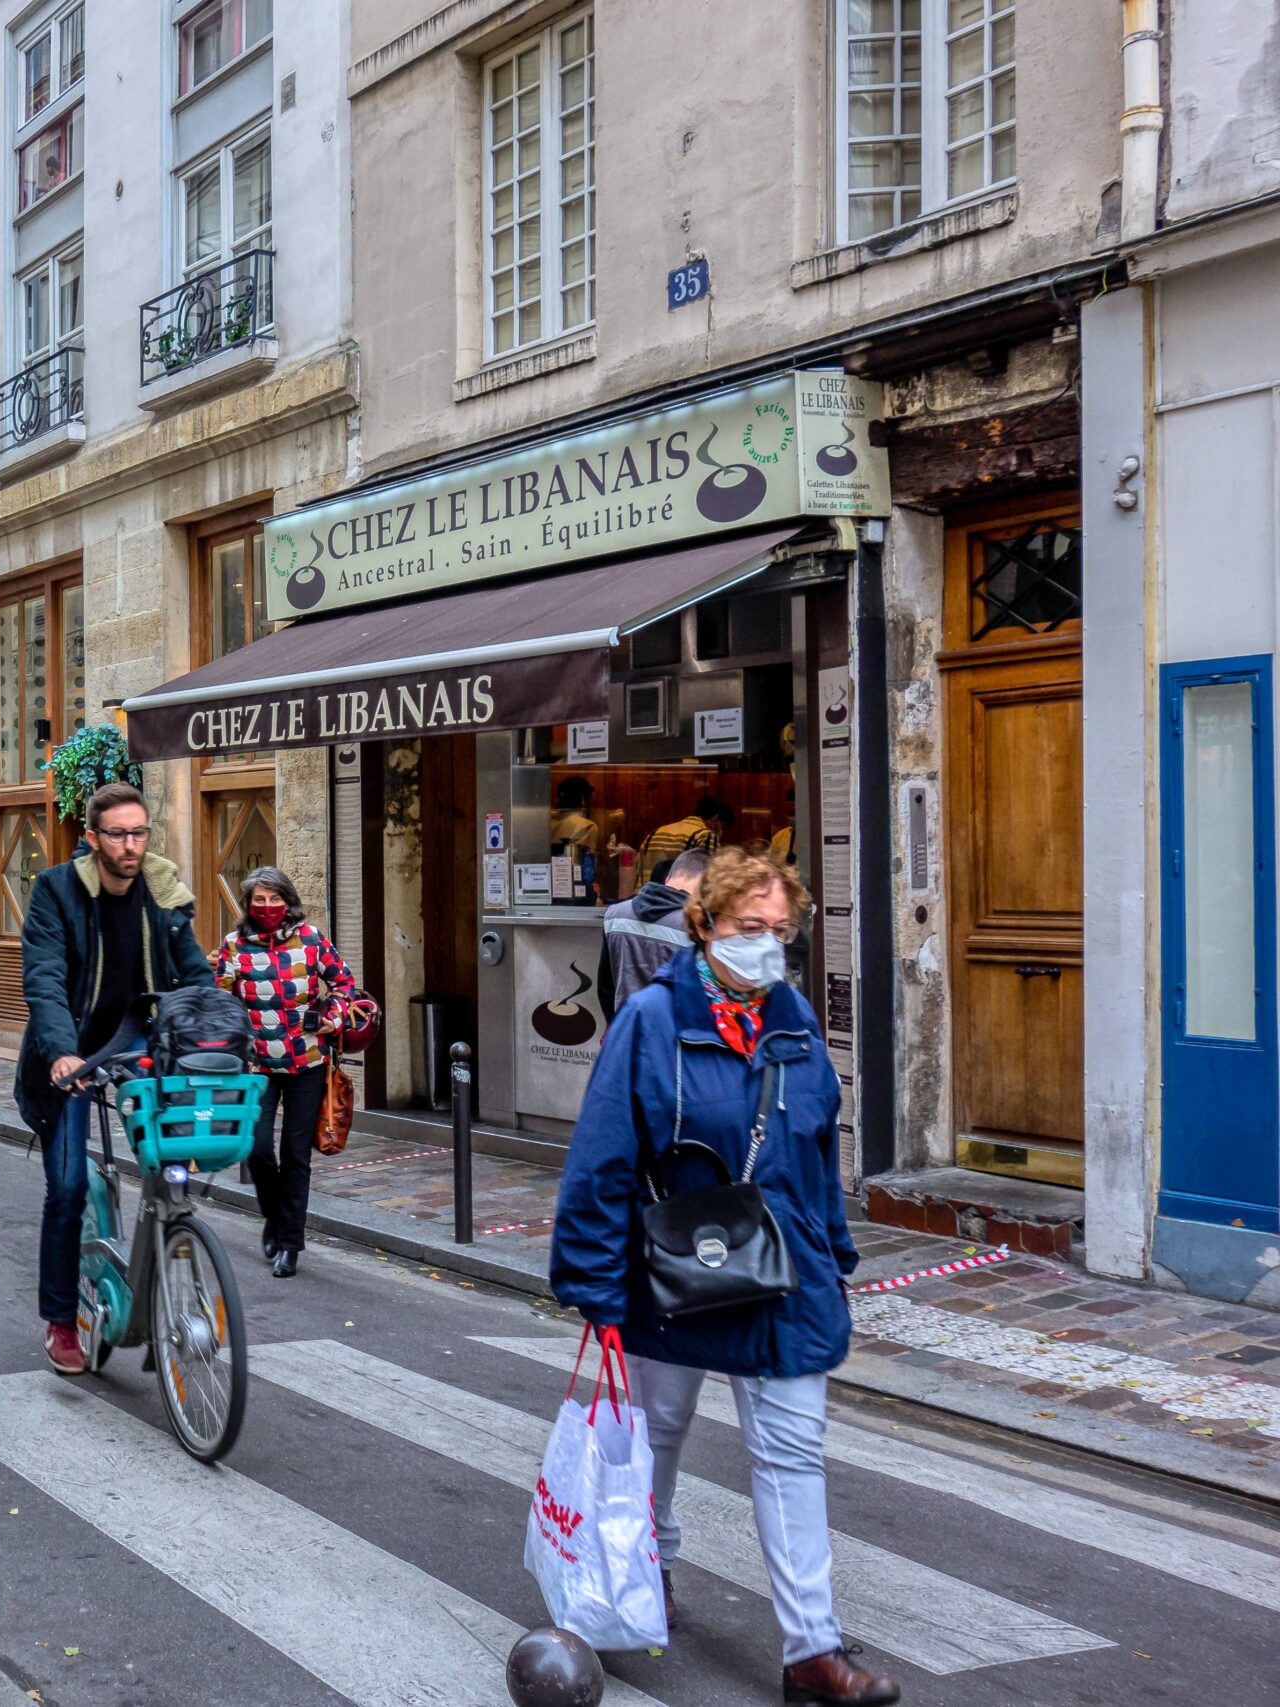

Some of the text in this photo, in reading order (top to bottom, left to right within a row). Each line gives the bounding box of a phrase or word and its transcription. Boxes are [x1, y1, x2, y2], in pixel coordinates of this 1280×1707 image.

[674, 266, 701, 301] 35
[819, 377, 847, 393] CHEZ
[801, 392, 865, 411] LE LIBANAIS
[743, 401, 794, 466] Farine Bio Farine Bio
[806, 479, 871, 490] Galettes Libanaises
[327, 430, 691, 561] CHEZ LE LIBANAIS
[814, 490, 865, 500] Traditionnelles
[813, 501, 828, 509] base
[829, 501, 838, 509] de
[337, 493, 674, 592] Ancestral Sain Équilibré
[187, 674, 495, 751] CHEZ LE LIBANAIS
[530, 1044, 551, 1055] CHEZ
[552, 1047, 561, 1057] LE
